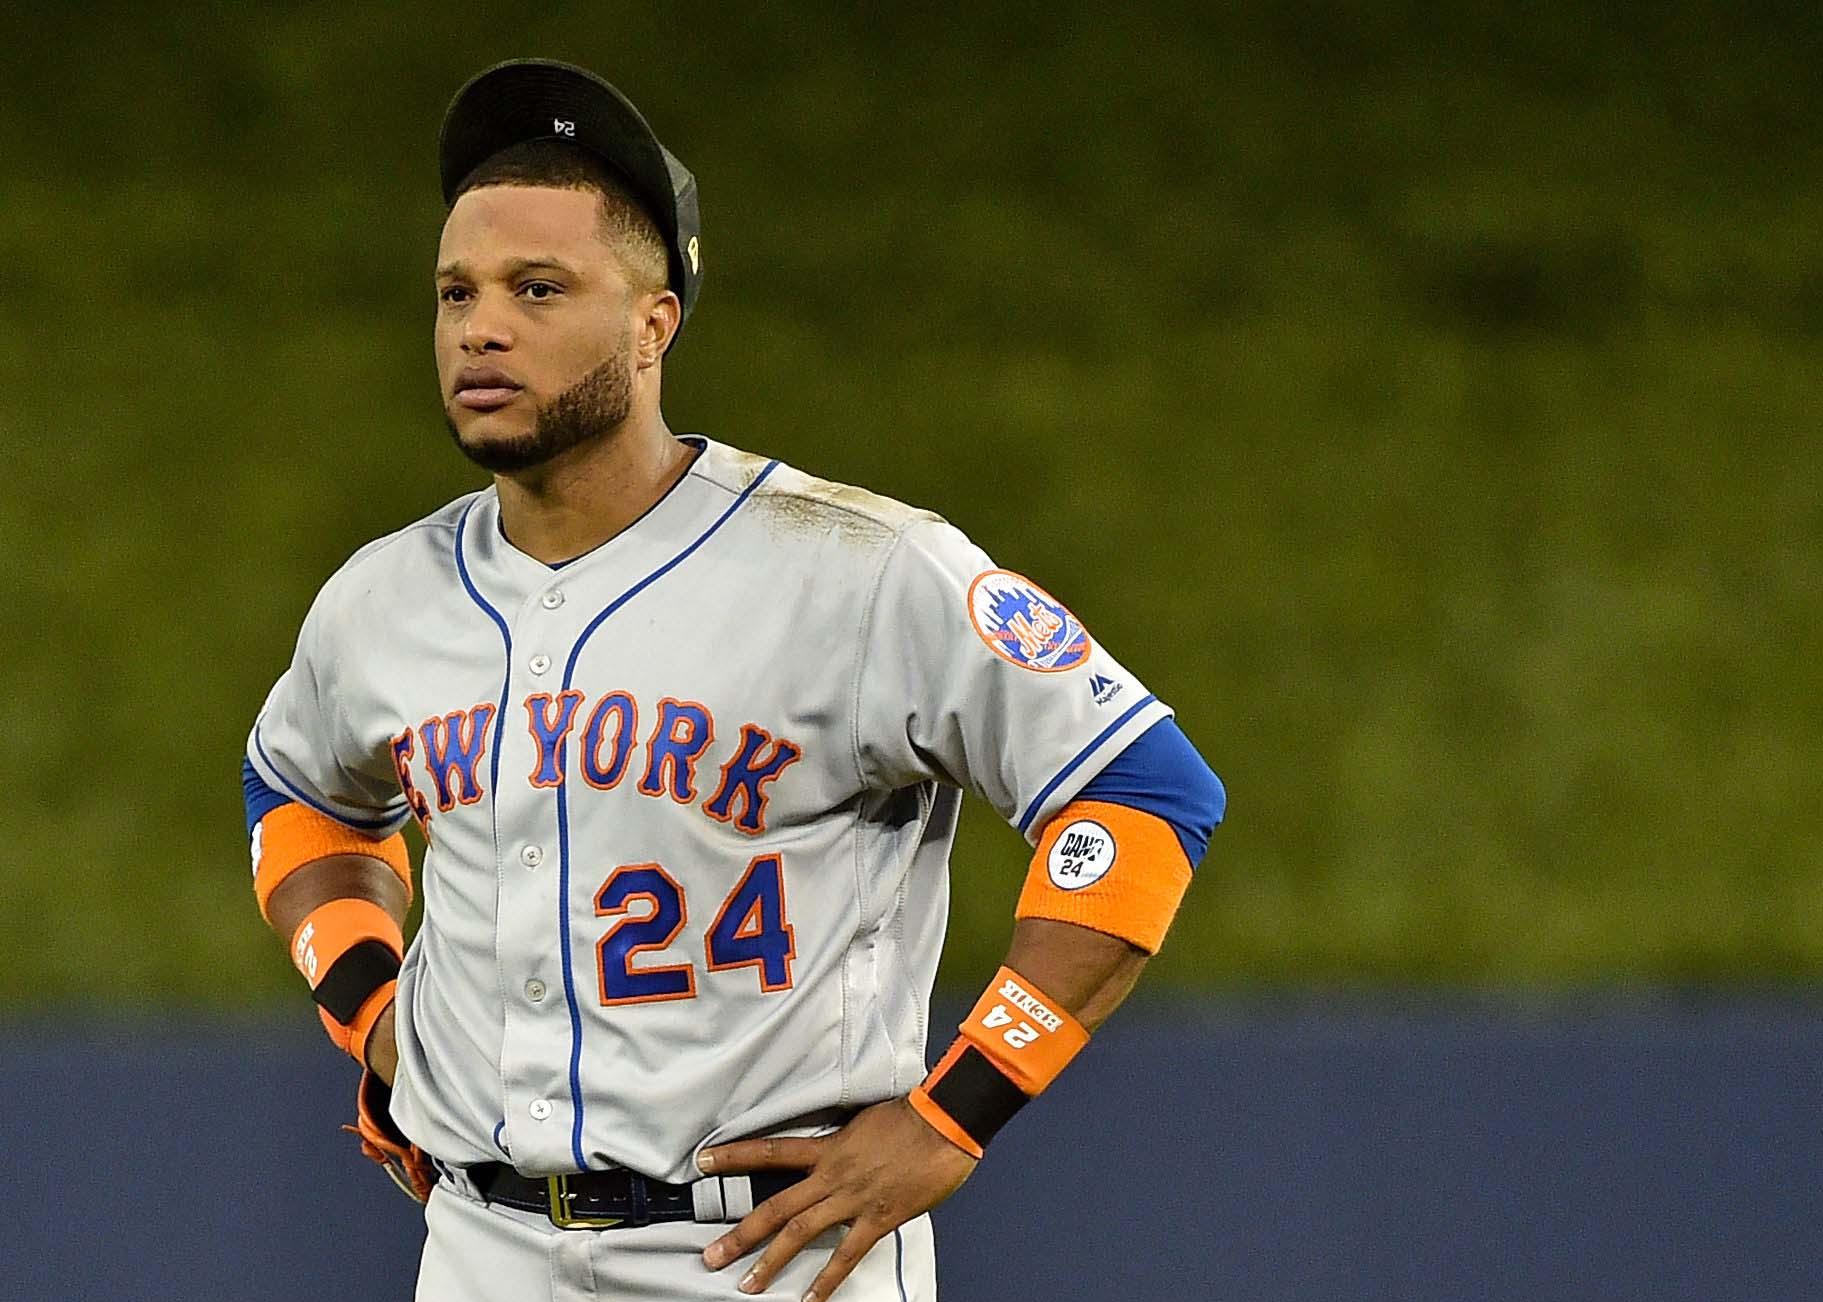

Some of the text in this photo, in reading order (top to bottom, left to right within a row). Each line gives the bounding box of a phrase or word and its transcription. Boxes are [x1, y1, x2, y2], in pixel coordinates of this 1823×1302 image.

[554, 118, 575, 136] 24
[1005, 602, 1065, 659] Mets
[523, 689, 801, 835] YORK
[1059, 858, 1084, 878] 24
[594, 852, 796, 1007] 24
[981, 1004, 1041, 1049] 24
